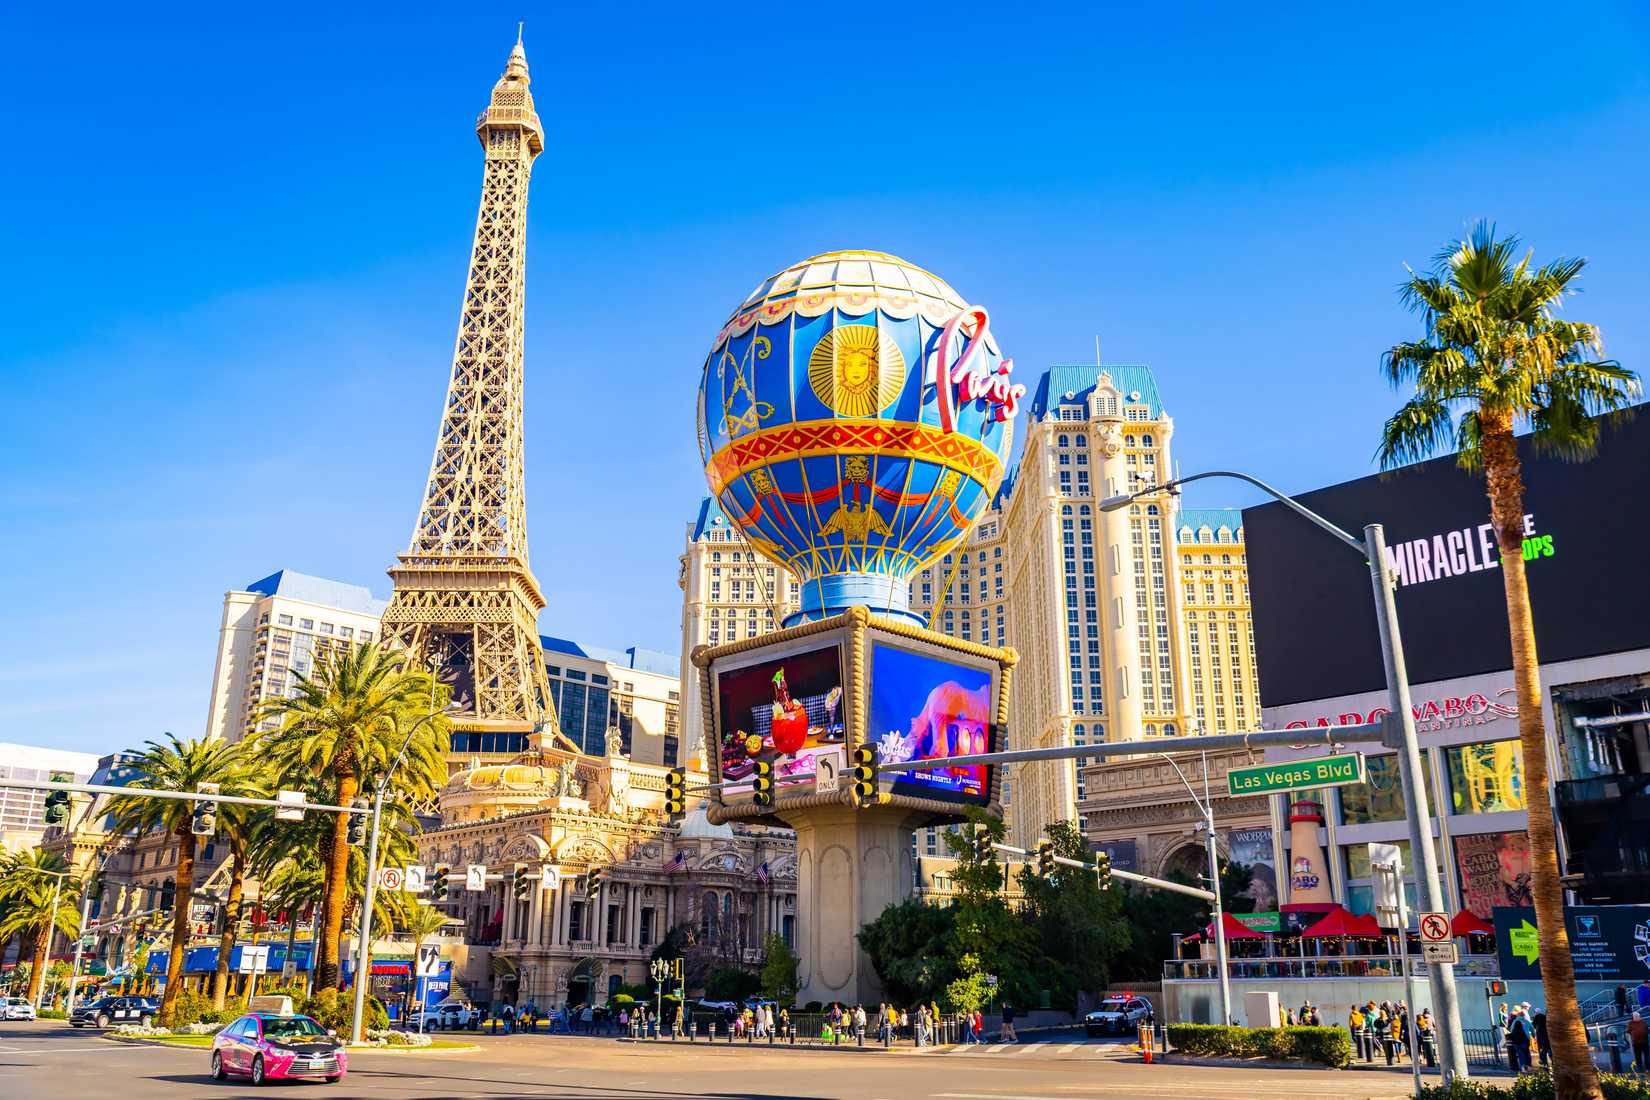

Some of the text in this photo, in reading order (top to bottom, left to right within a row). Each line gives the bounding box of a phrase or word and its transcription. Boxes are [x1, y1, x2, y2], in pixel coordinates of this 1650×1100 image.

[936, 305, 1027, 435] Paris
[1385, 523, 1499, 587] MIRACLE
[1418, 715, 1487, 733] ANTINA
[818, 780, 836, 791] ONLY
[1233, 762, 1353, 789] Las Vegas Blvd
